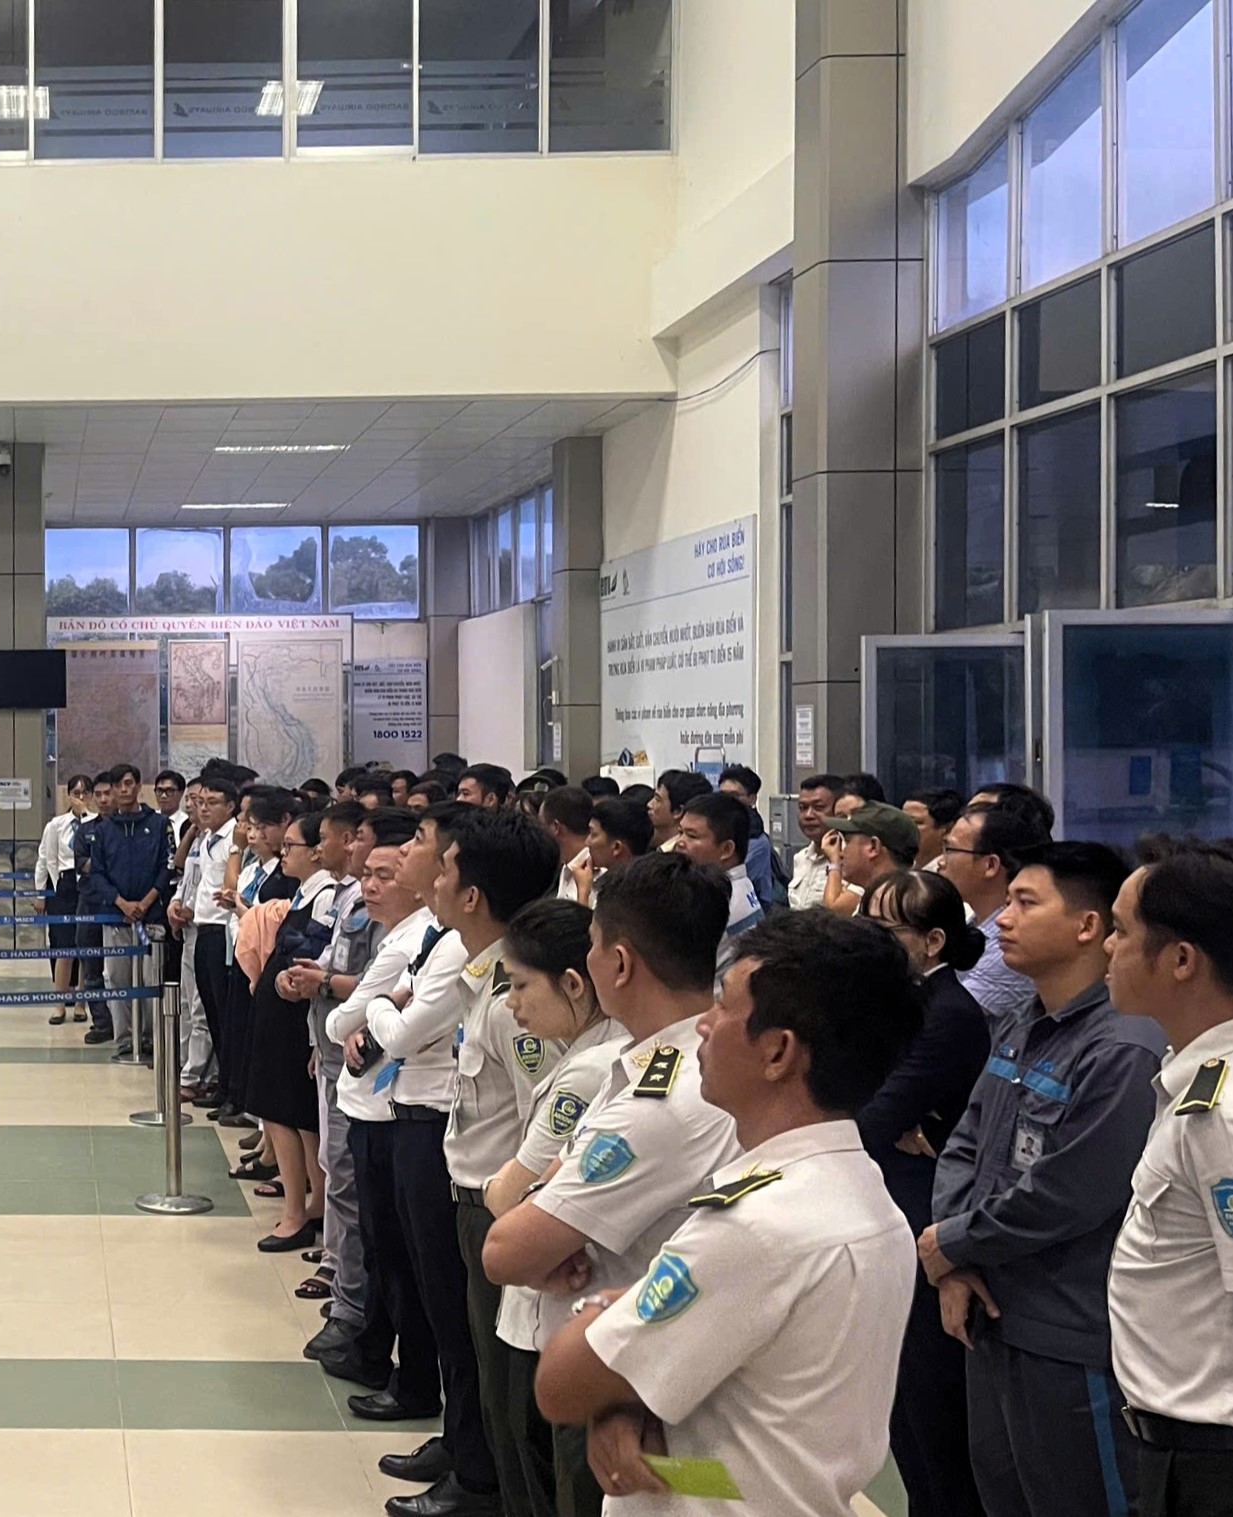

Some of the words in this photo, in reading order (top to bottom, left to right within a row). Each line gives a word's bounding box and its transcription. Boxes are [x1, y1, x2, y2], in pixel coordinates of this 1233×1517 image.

[131, 618, 158, 630] CHỦ
[246, 617, 272, 629] ĐẢO
[278, 618, 305, 629] VIỆT
[311, 619, 339, 628] NAM
[373, 730, 398, 739] 1800
[401, 730, 422, 739] 1522
